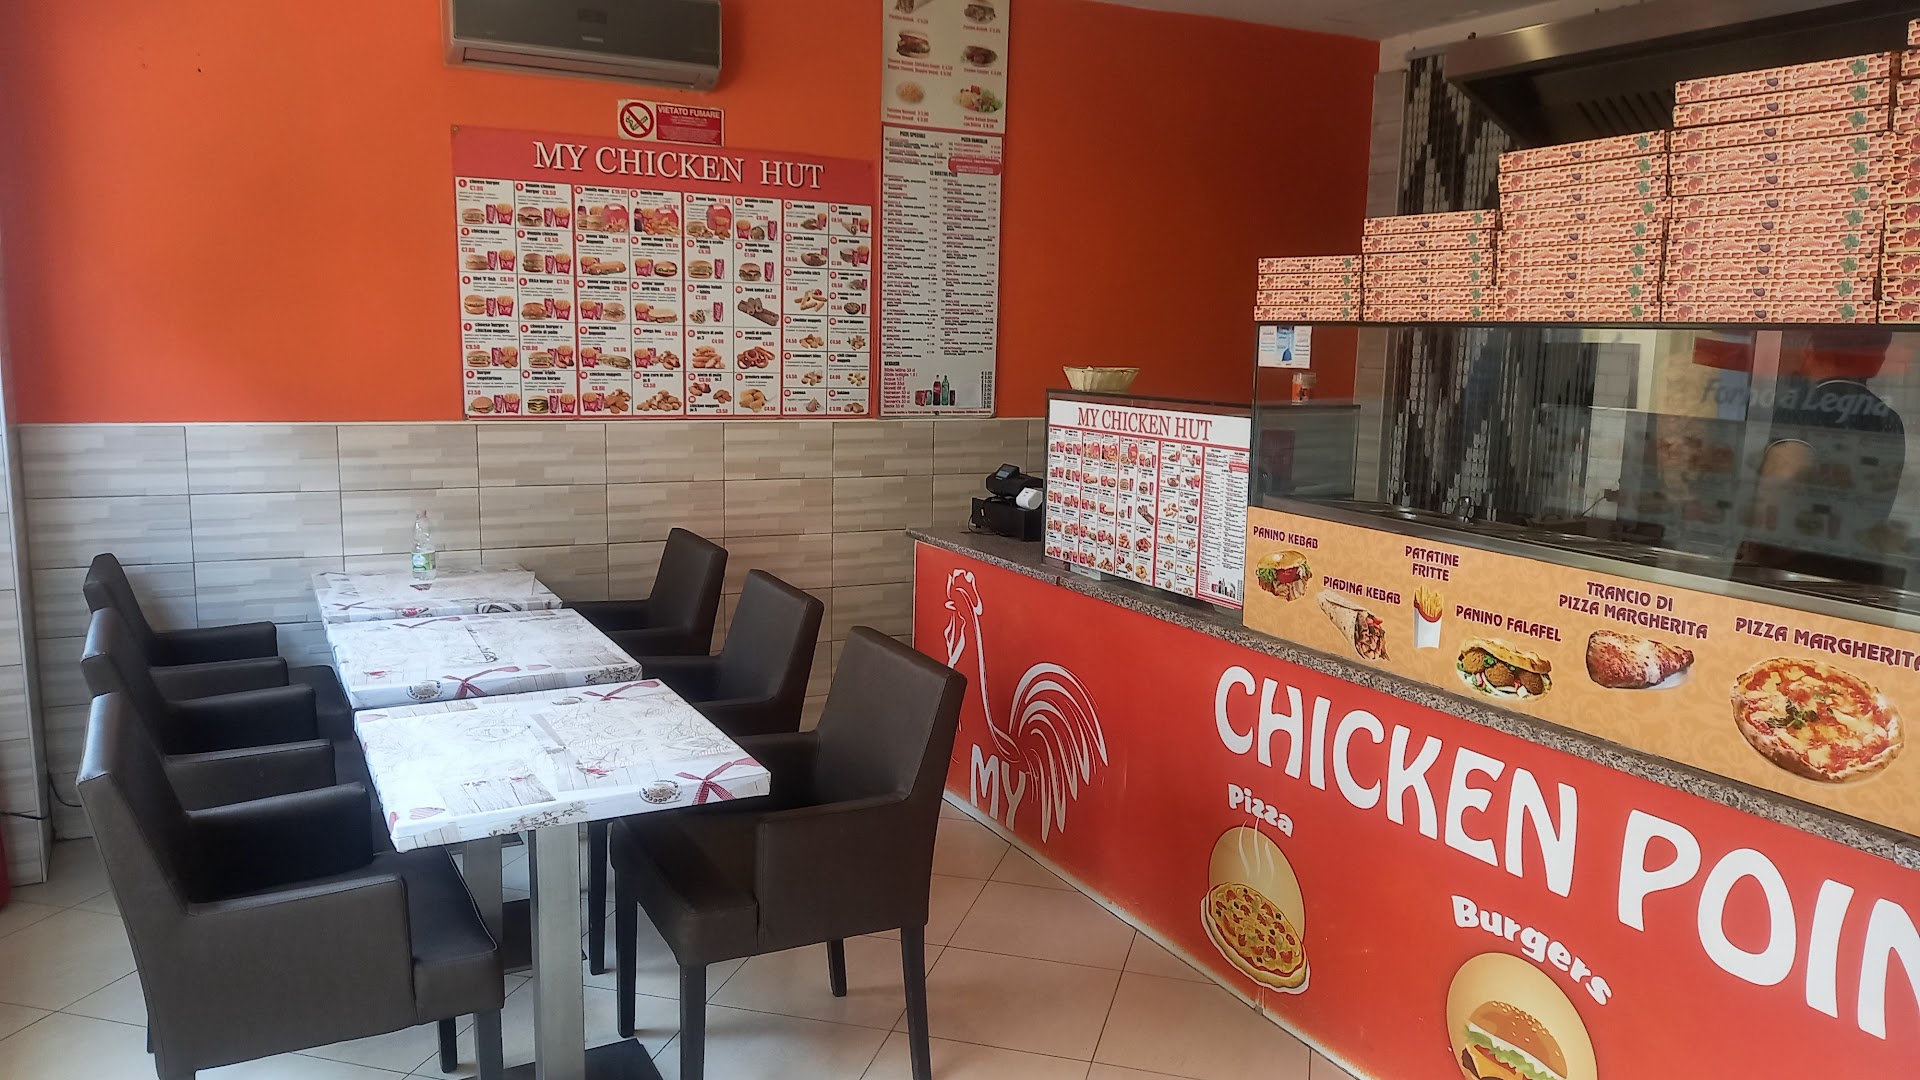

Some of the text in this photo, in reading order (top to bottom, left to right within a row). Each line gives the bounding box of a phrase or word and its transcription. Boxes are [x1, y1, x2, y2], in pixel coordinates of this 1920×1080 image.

[658, 106, 720, 119] VIETATO FUMARE
[533, 141, 824, 188] MY CHICKEN HUT
[1078, 408, 1212, 441] MY CHICKEN HUT
[1253, 526, 1319, 549] PANINO KEBAB
[1405, 546, 1460, 567] PATATINE
[1412, 563, 1450, 582] FRITTE
[1323, 576, 1401, 605] PIADINA KEBAB
[1587, 582, 1673, 611] TRANCIO DI
[1456, 606, 1562, 642] PANINO FALAFEL
[1559, 594, 1708, 639] PIZZA MARGHERITA
[1736, 618, 1788, 642] PIZZA
[970, 743, 1027, 832] MY
[1214, 665, 1578, 898] CHICKEN
[1228, 783, 1294, 838] Pizza
[1451, 895, 1612, 1006] Burgers
